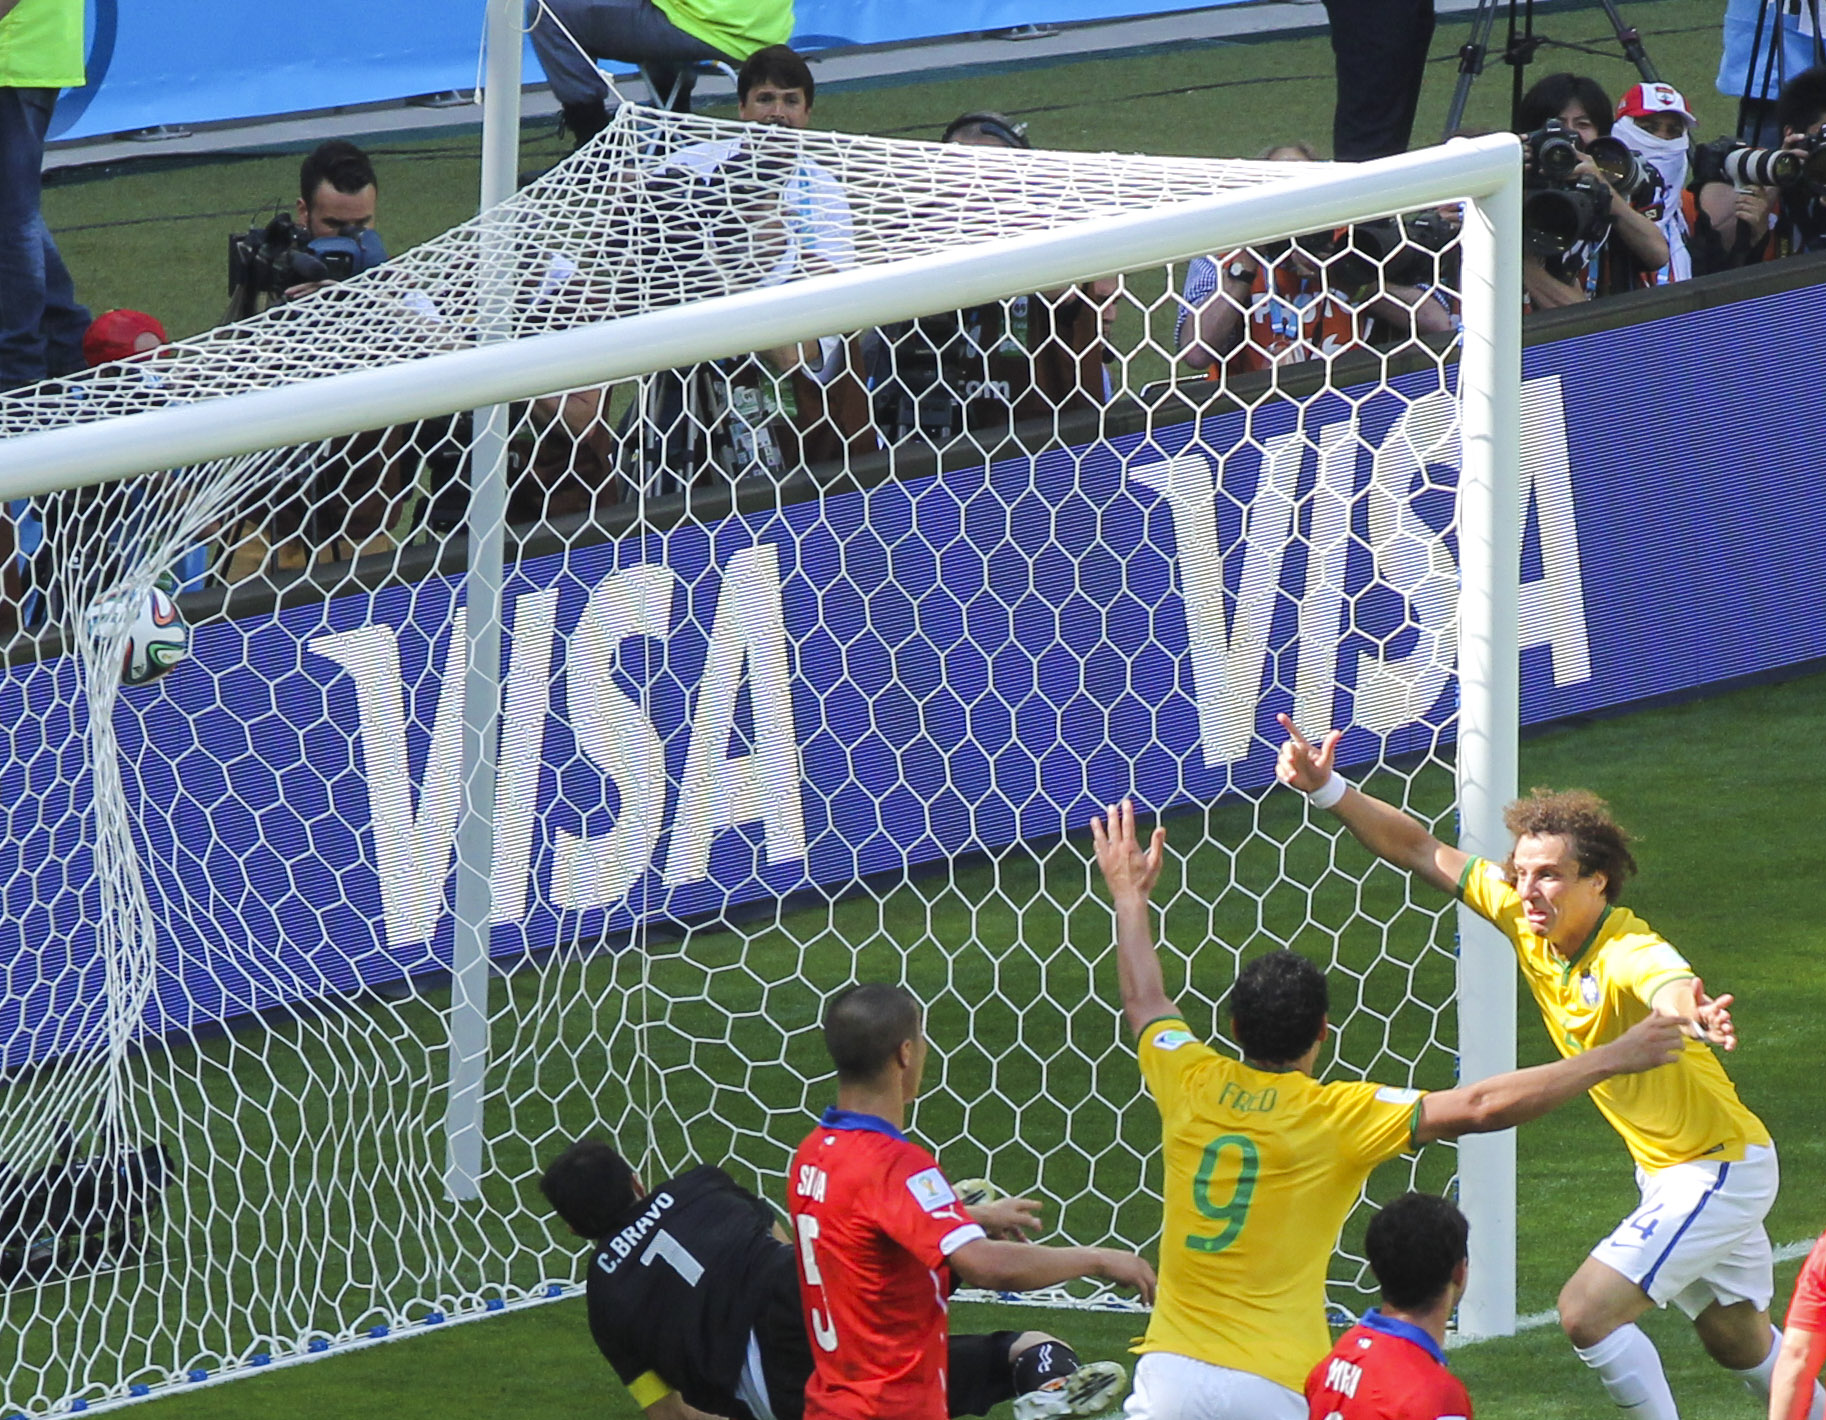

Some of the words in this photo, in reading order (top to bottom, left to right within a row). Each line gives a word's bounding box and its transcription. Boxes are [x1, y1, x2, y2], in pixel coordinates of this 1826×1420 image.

[308, 543, 807, 948] VISA
[597, 1192, 675, 1274] C.BRAVO
[1184, 1133, 1260, 1254] 9
[640, 1228, 705, 1287] 1
[797, 1213, 838, 1352] 5
